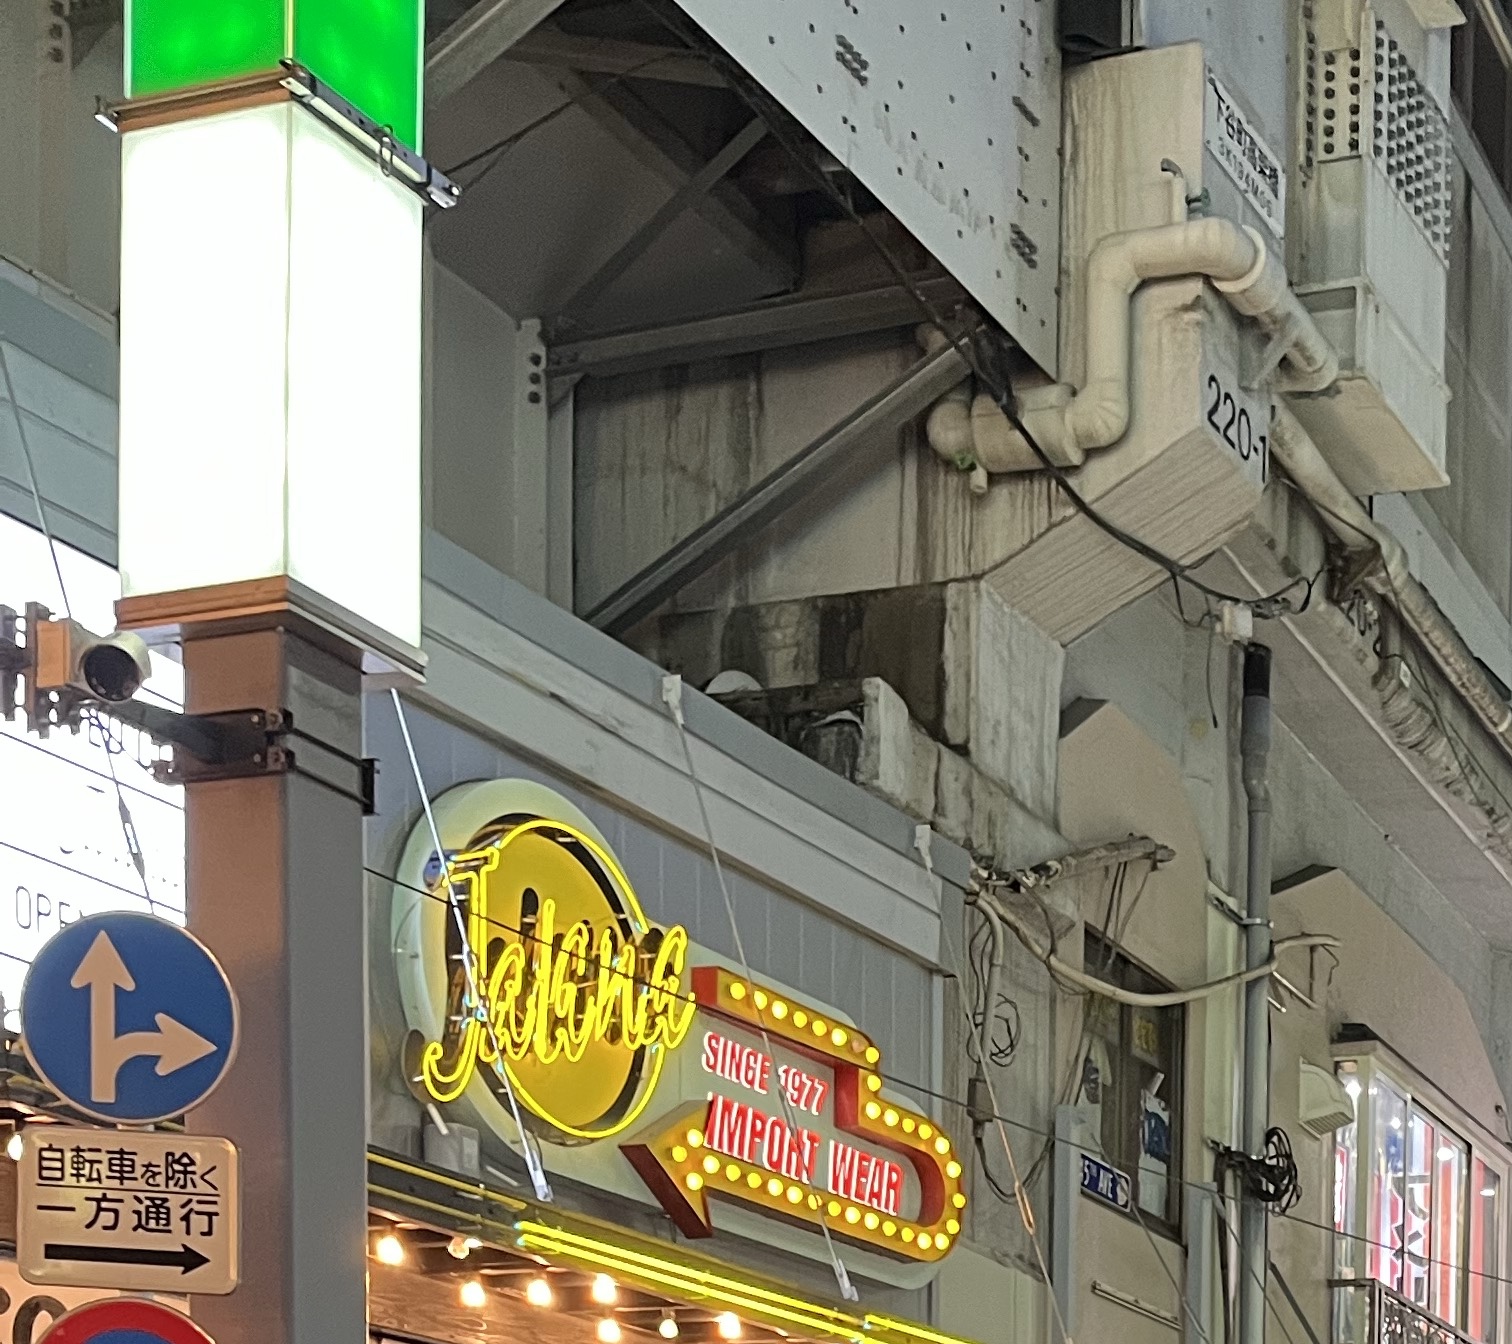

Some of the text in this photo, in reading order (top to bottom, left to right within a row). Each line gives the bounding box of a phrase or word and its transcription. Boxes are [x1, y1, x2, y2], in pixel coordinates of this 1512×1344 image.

[1206, 374, 1267, 484] 220-1
[15, 886, 84, 931] OPE
[702, 1031, 830, 1116] SINCE 1977
[37, 1143, 220, 1192] 自転車を除く
[703, 1091, 905, 1217] IMPORT WEAR
[36, 1193, 220, 1237] 一方通行
